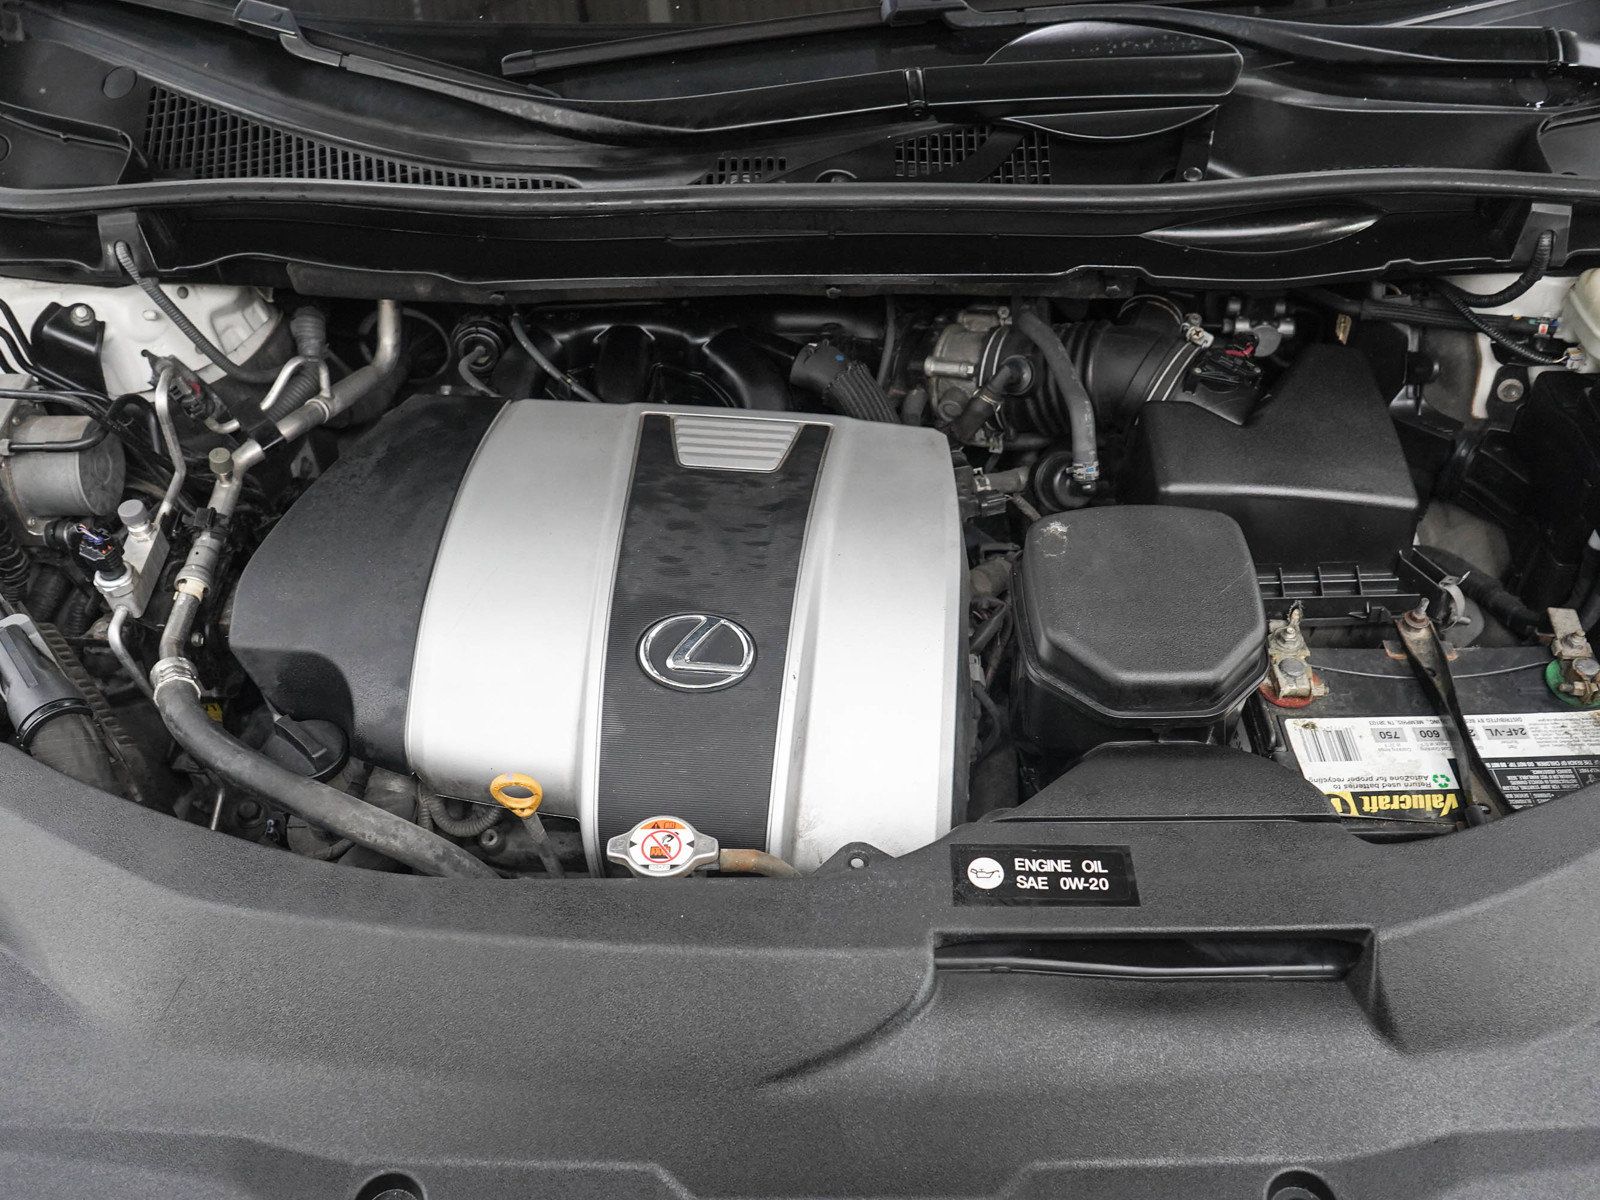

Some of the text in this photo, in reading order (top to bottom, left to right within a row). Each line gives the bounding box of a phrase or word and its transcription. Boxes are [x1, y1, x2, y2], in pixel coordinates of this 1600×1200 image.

[1379, 731, 1400, 739] 750
[1420, 730, 1440, 738] 600
[1485, 728, 1526, 736] 24F-VL
[1308, 776, 1344, 784] recycling
[1359, 794, 1458, 817] Valucraft
[1014, 858, 1109, 873] ENGINE OIL
[1016, 875, 1110, 891] SAE 0W-20
